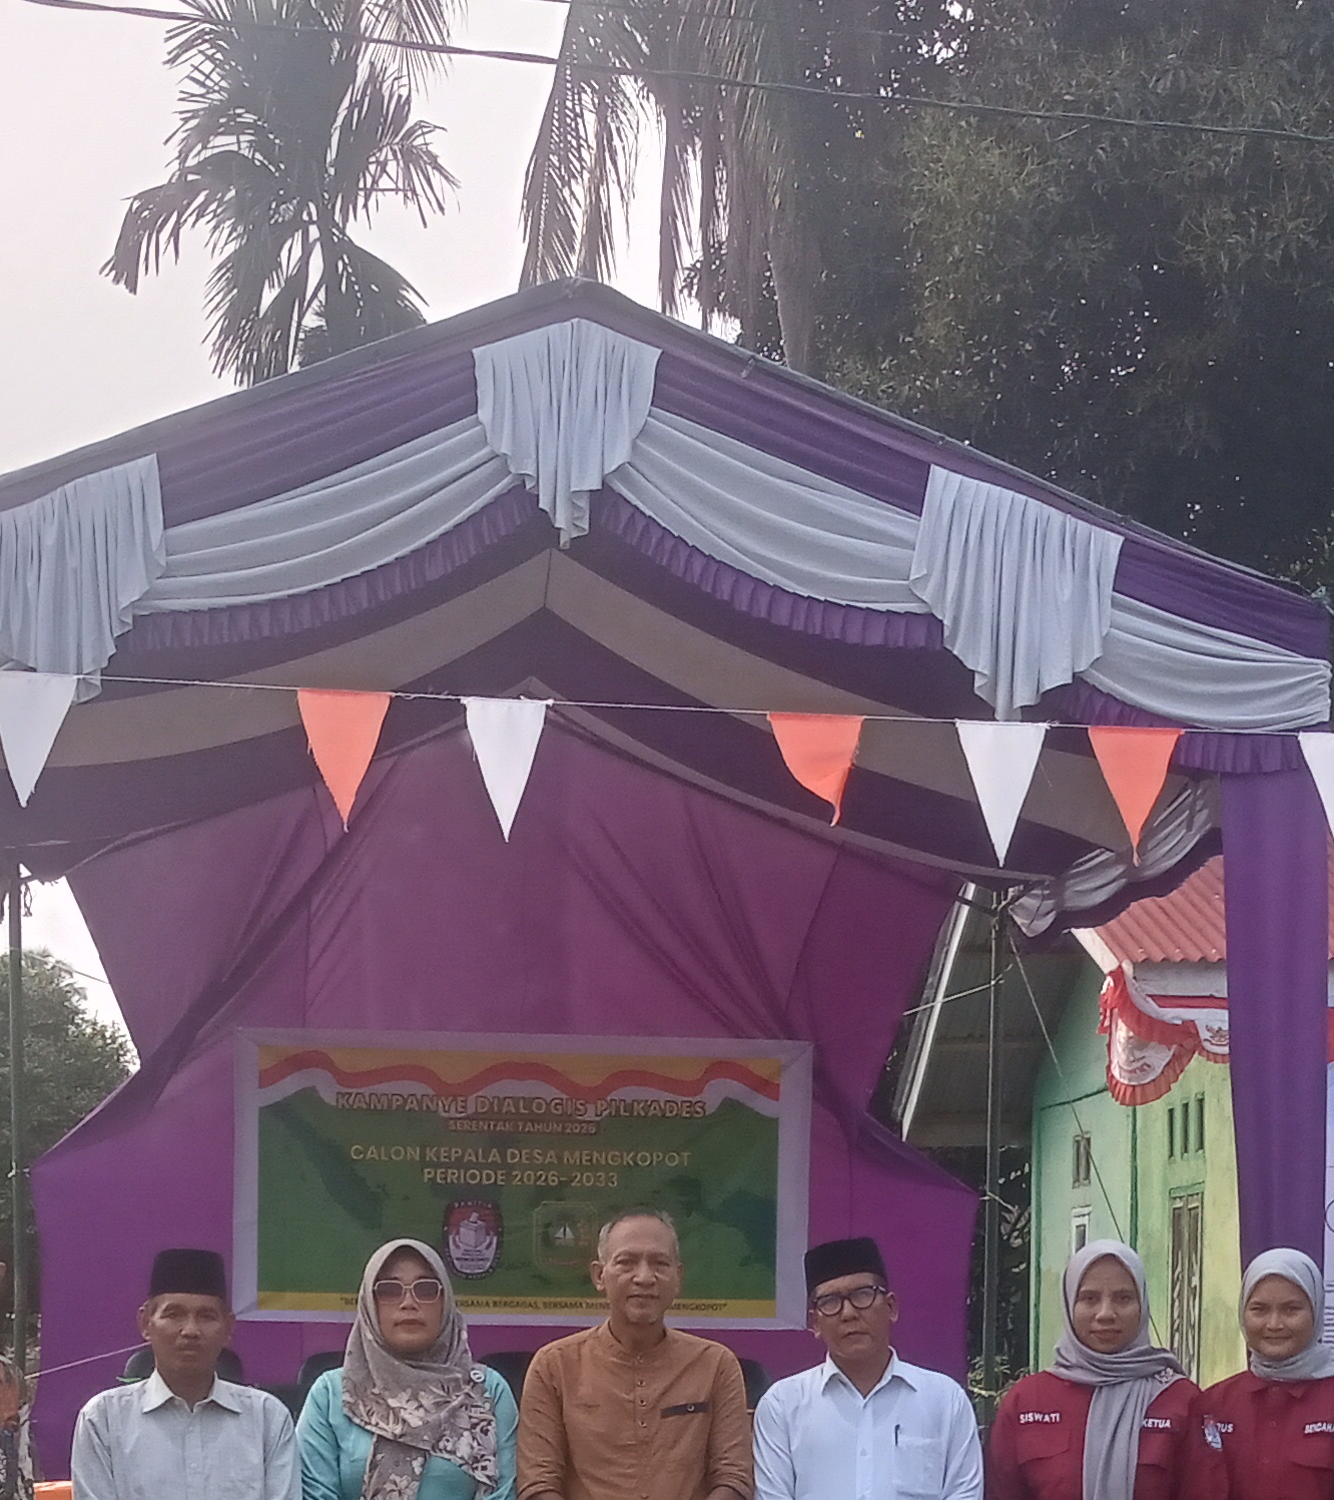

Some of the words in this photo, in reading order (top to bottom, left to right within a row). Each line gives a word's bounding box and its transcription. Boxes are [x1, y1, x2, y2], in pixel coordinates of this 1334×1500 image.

[336, 1092, 466, 1113] KAMPANYE
[474, 1095, 587, 1116] DIALOGIS
[595, 1099, 707, 1118] PILKADES
[448, 1120, 514, 1132] SERENTAK
[518, 1121, 562, 1133] TAHUN
[566, 1123, 596, 1134] 2026
[350, 1145, 420, 1161] CALON
[426, 1147, 501, 1163] KEPALA
[507, 1149, 557, 1164] DESA
[564, 1150, 691, 1166] MENGKOPOT
[423, 1168, 505, 1185] PERIODE
[1019, 1411, 1060, 1424] SISWATI
